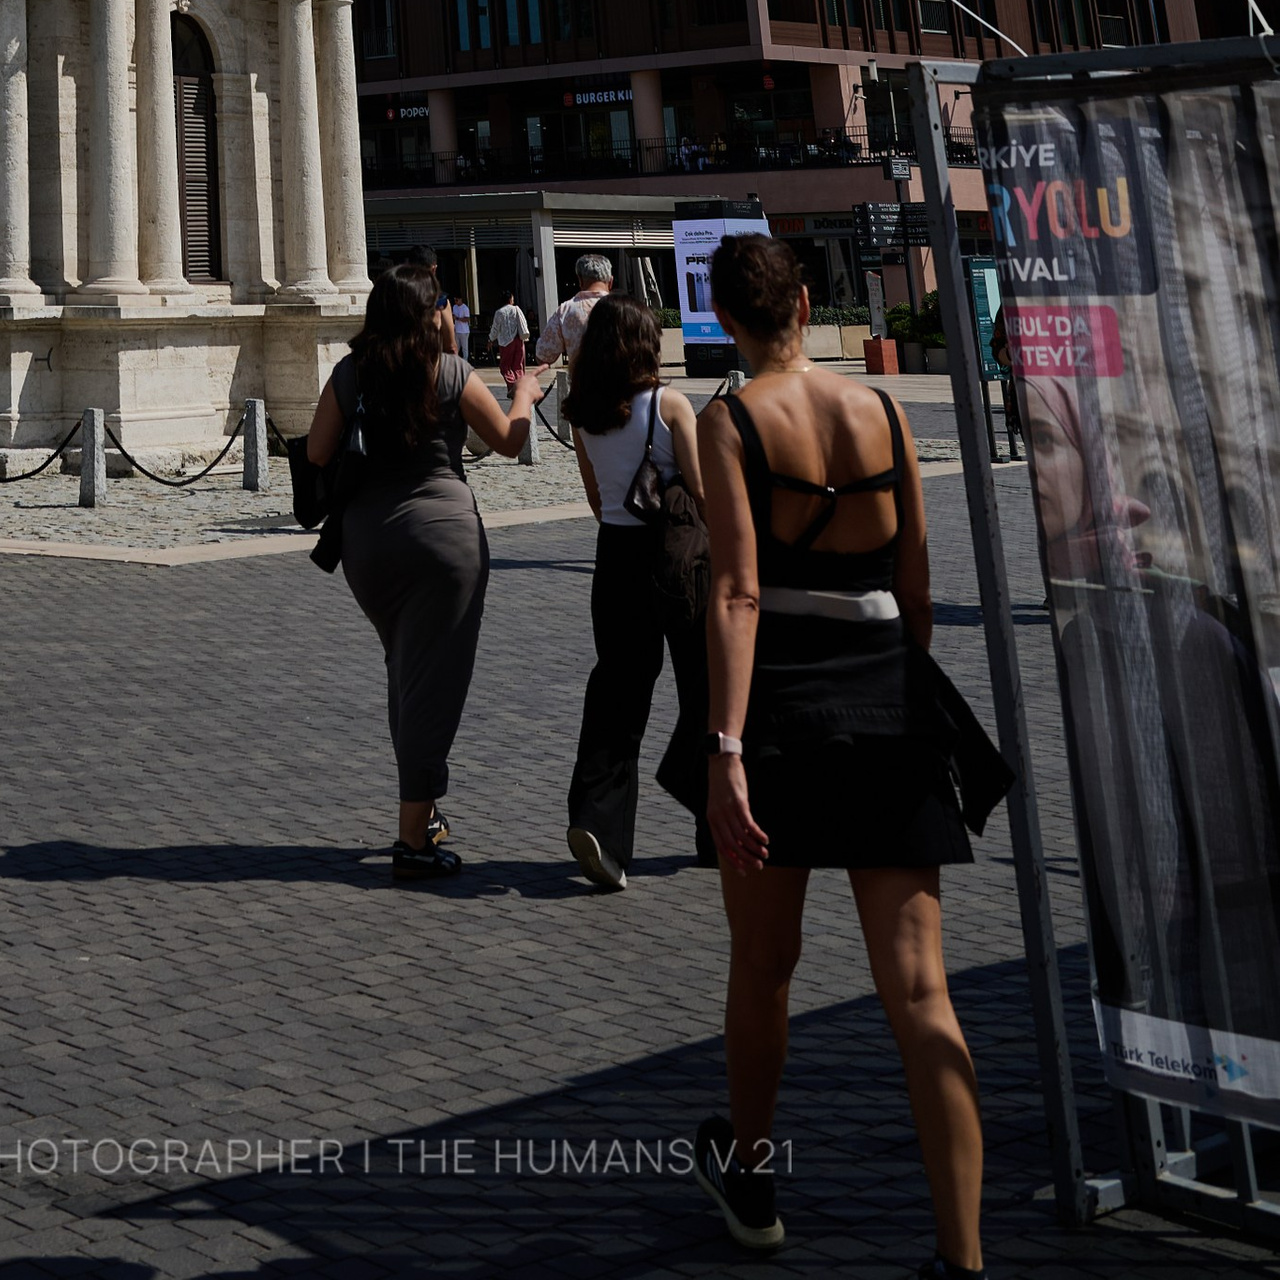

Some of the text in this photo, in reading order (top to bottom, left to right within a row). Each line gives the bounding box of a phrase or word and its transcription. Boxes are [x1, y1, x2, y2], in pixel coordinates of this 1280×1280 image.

[576, 90, 616, 105] BURGER
[1111, 1042, 1218, 1081] Türk Telekom
